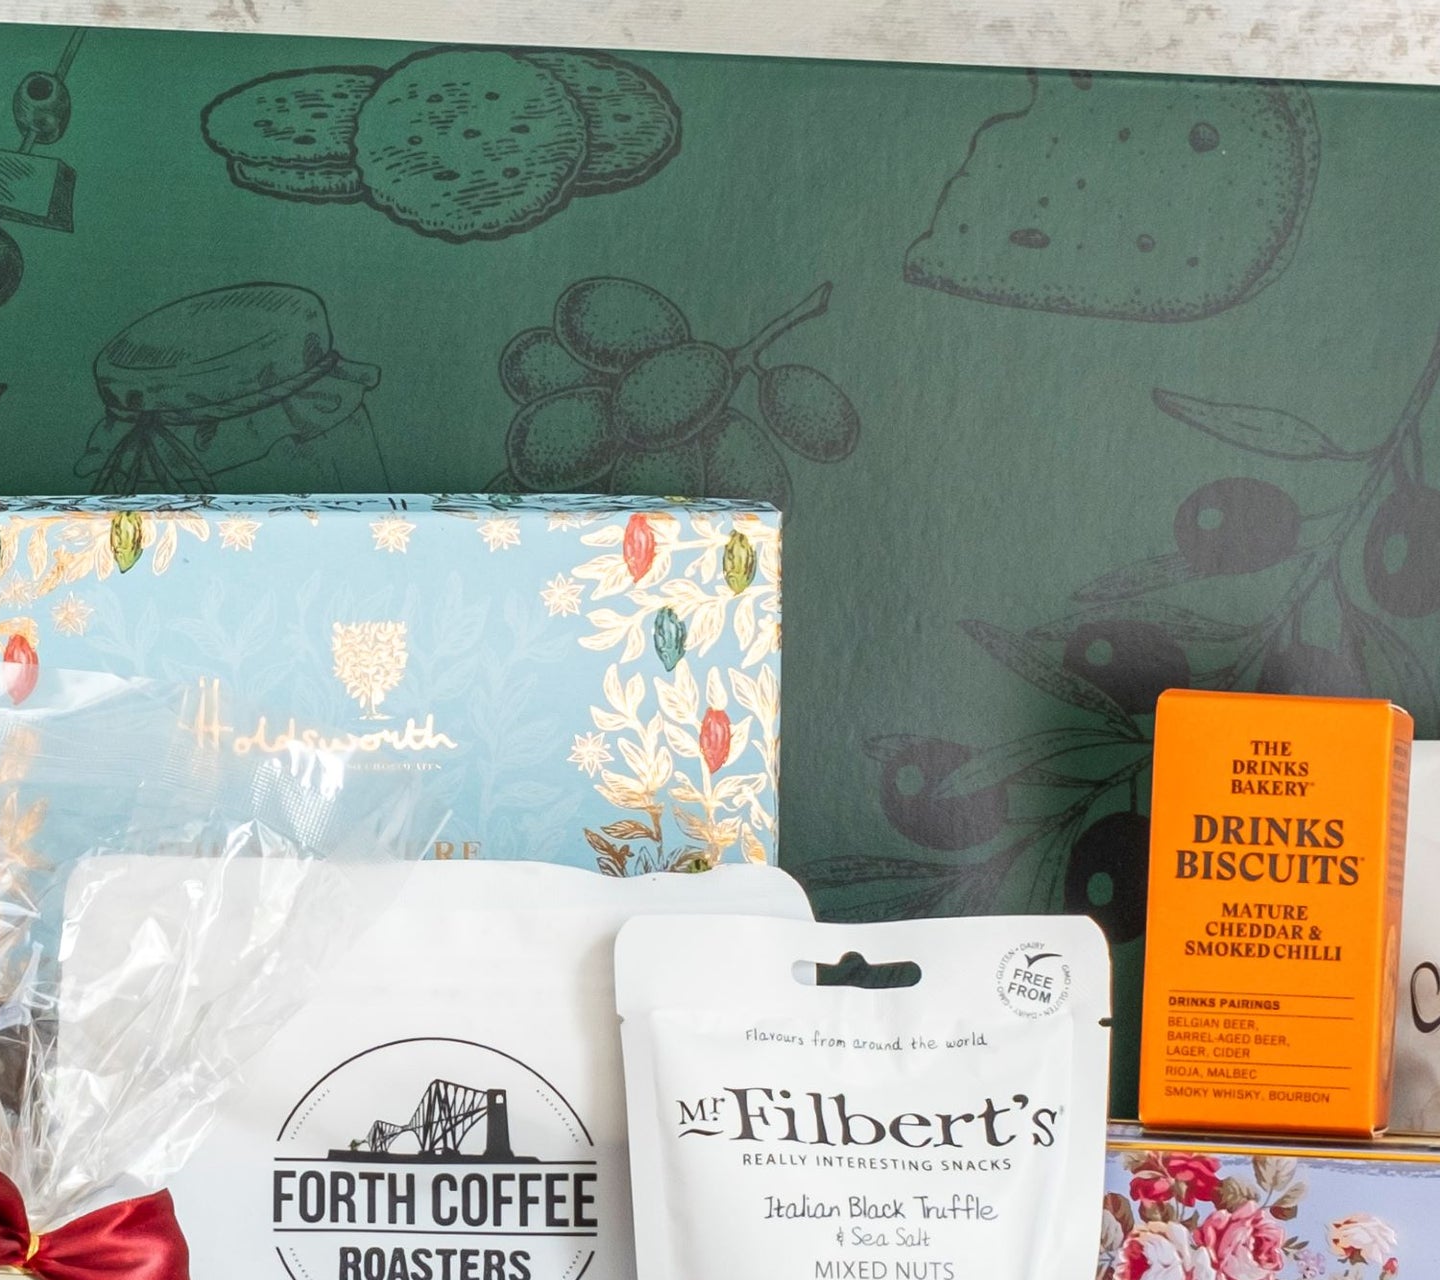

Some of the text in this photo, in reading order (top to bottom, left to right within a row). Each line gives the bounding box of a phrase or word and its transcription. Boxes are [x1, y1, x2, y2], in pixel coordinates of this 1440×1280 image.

[1251, 740, 1292, 756] THE
[1233, 759, 1309, 777] DRINKS
[1231, 779, 1309, 797] BAKERY
[1193, 814, 1344, 849] DRINKS
[1175, 850, 1359, 886] BISCUITS
[1222, 903, 1308, 921] MATURE
[1206, 921, 1322, 941] CHEDDAR &
[1185, 940, 1341, 961] SMOKED CHILLI
[1013, 968, 1054, 990] FREE
[1008, 982, 1052, 1004] FROM
[1169, 996, 1280, 1010] DRINKS PAIRINGS
[745, 1028, 987, 1051] Flavours from around the world
[1213, 1047, 1250, 1058] CIDER
[1207, 1068, 1258, 1080] MALBEC
[1269, 1091, 1330, 1103] BOURBON
[676, 1087, 1058, 1148] Mr Filbert's
[743, 1152, 1012, 1171] REALLY INTERESTING SNACKS
[273, 1170, 597, 1227] FORTH COFFEE
[764, 1194, 999, 1221] Italian Black Truffle
[851, 1226, 931, 1247] Sea Salt
[815, 1261, 954, 1280] MIXED NUTS
